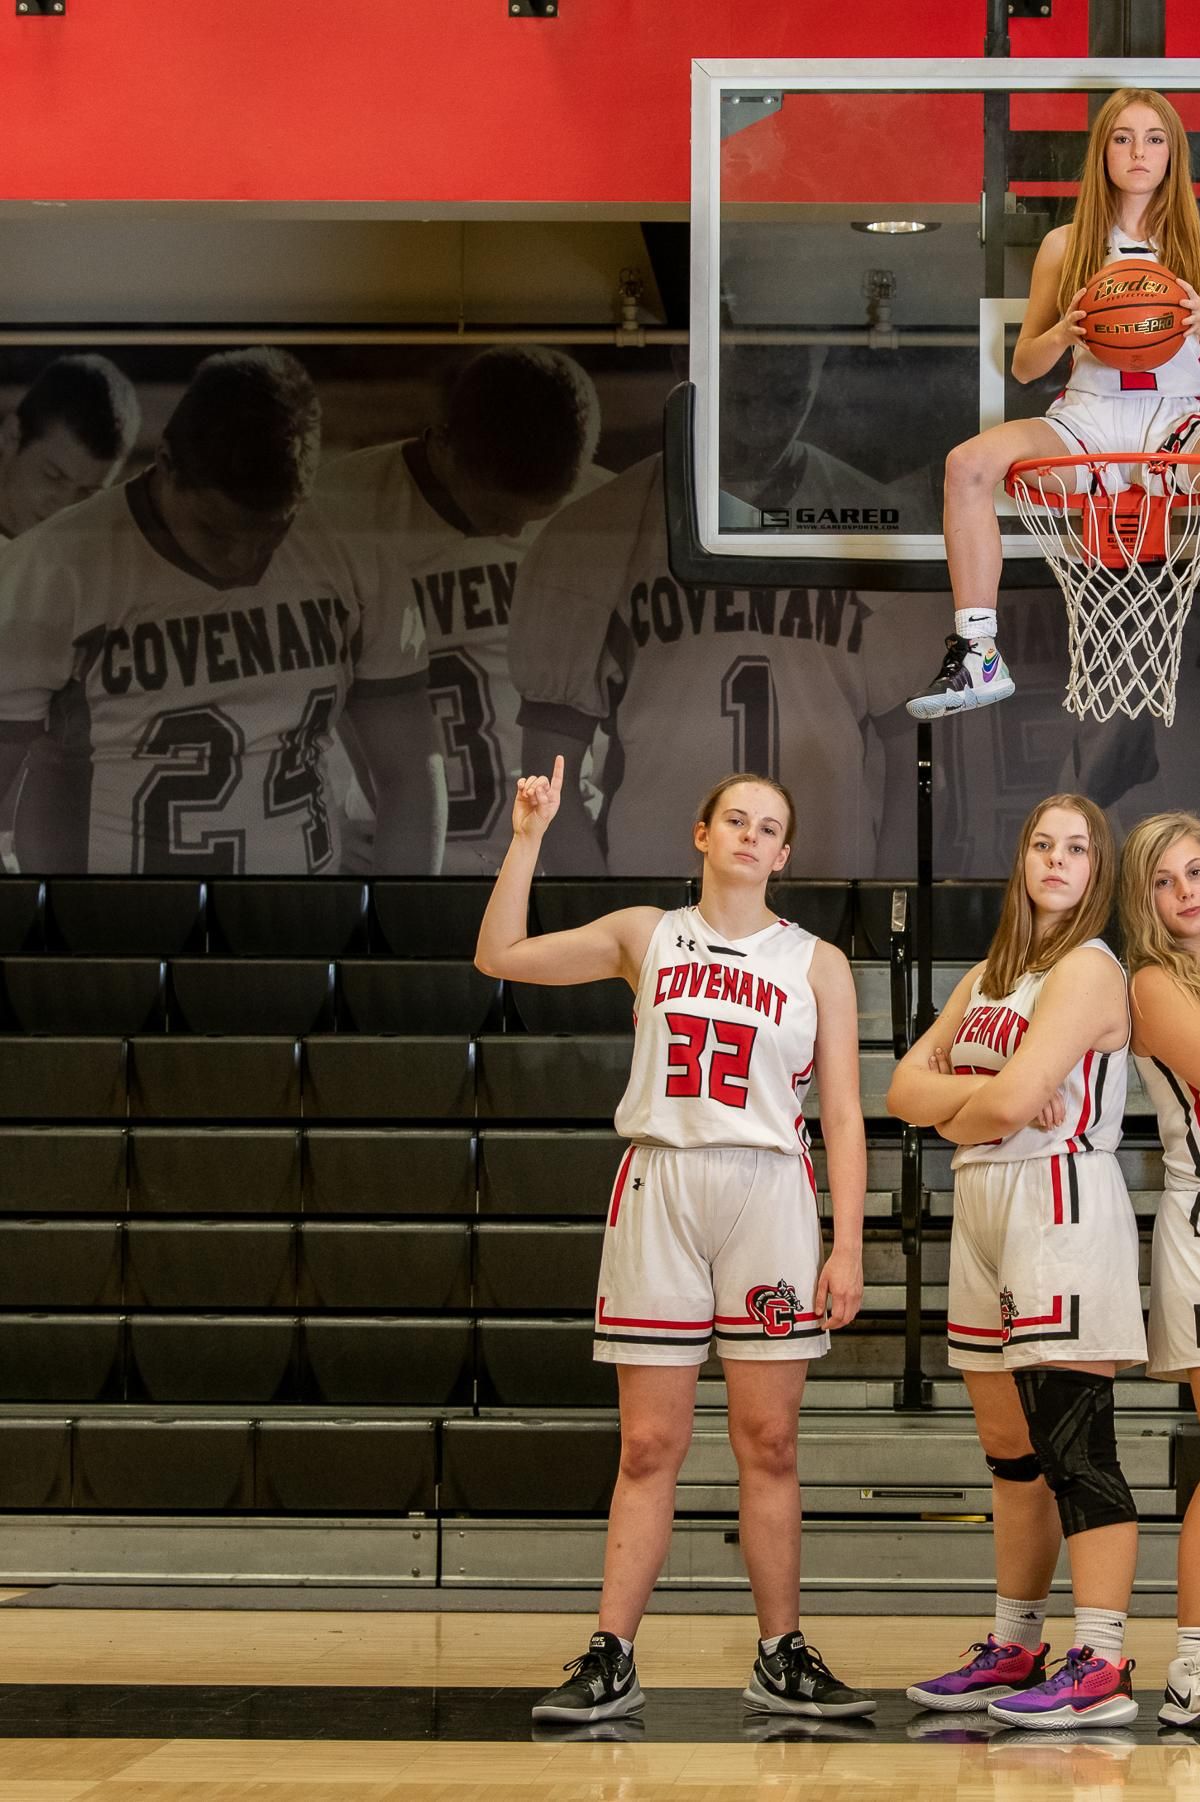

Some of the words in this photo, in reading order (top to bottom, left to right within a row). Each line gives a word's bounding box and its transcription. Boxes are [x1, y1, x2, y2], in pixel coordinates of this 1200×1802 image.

[1094, 275, 1168, 302] Baden
[796, 508, 900, 524] GARED
[132, 682, 337, 874] 24
[653, 962, 788, 1026] COVENANT
[664, 1012, 758, 1109] 32
